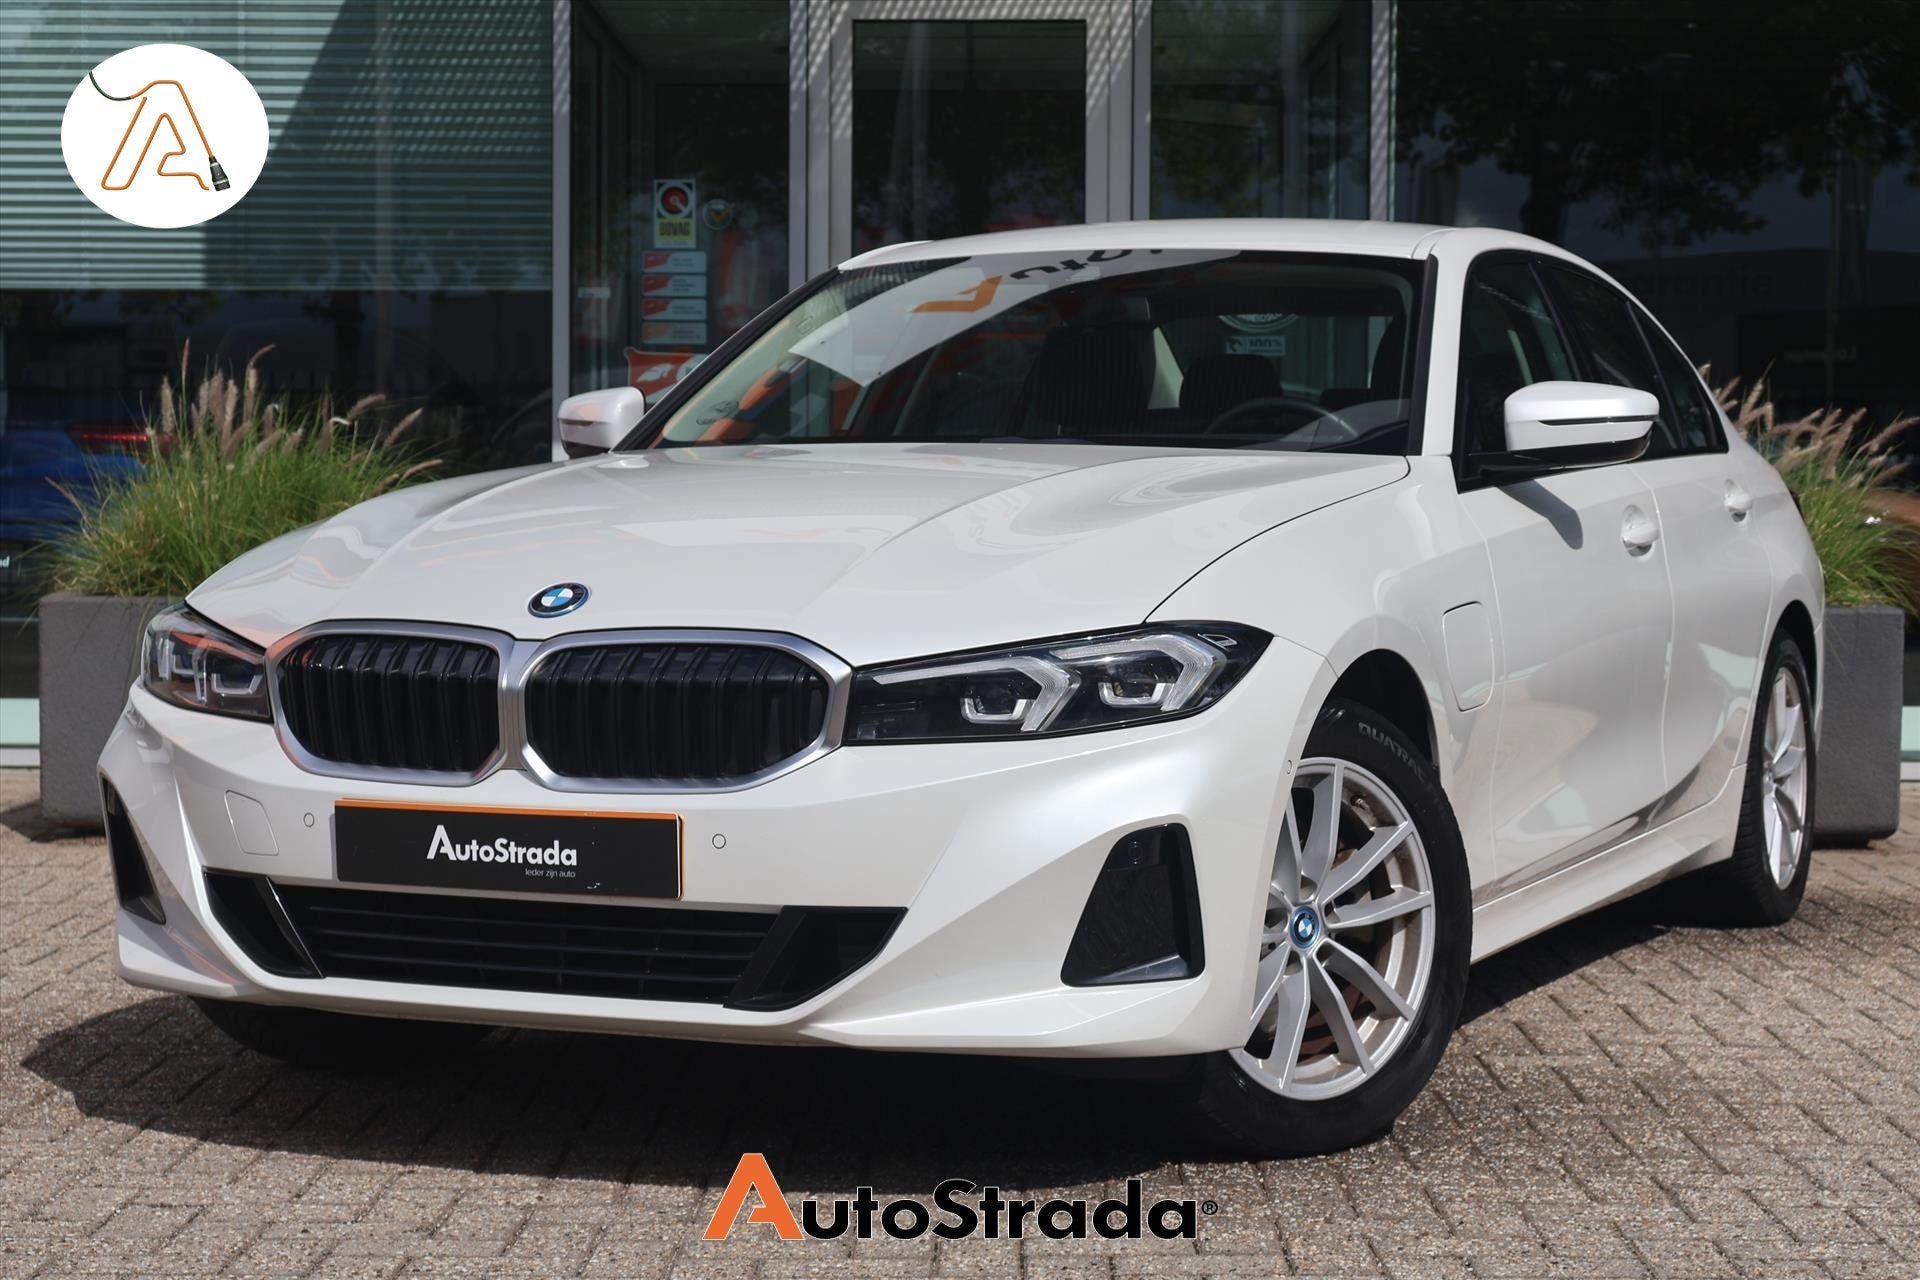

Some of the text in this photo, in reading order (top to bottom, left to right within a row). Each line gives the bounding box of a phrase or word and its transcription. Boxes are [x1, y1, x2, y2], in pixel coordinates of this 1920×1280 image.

[427, 824, 577, 866] AutoStrada
[545, 869, 558, 879] zijn
[559, 869, 576, 878] auto
